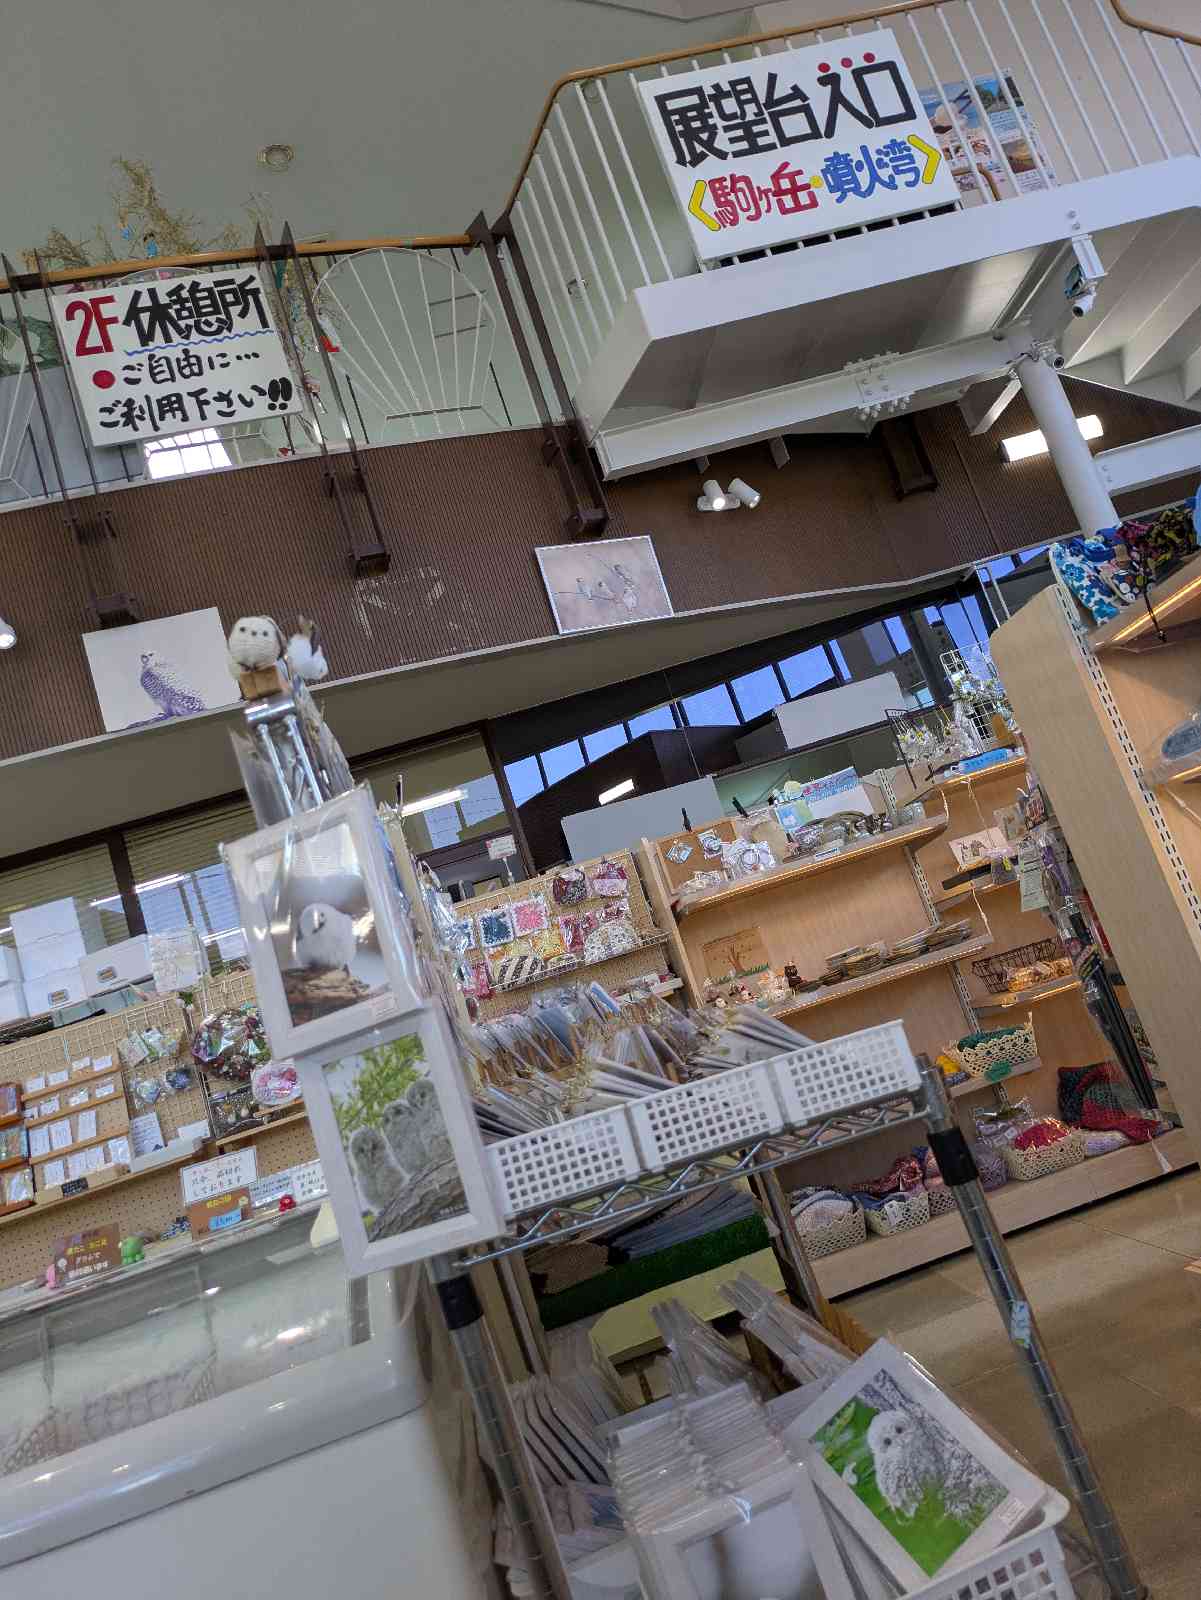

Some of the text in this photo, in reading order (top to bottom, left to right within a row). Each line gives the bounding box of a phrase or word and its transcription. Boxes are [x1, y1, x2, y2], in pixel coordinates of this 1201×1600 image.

[654, 60, 917, 168] 展望台入口
